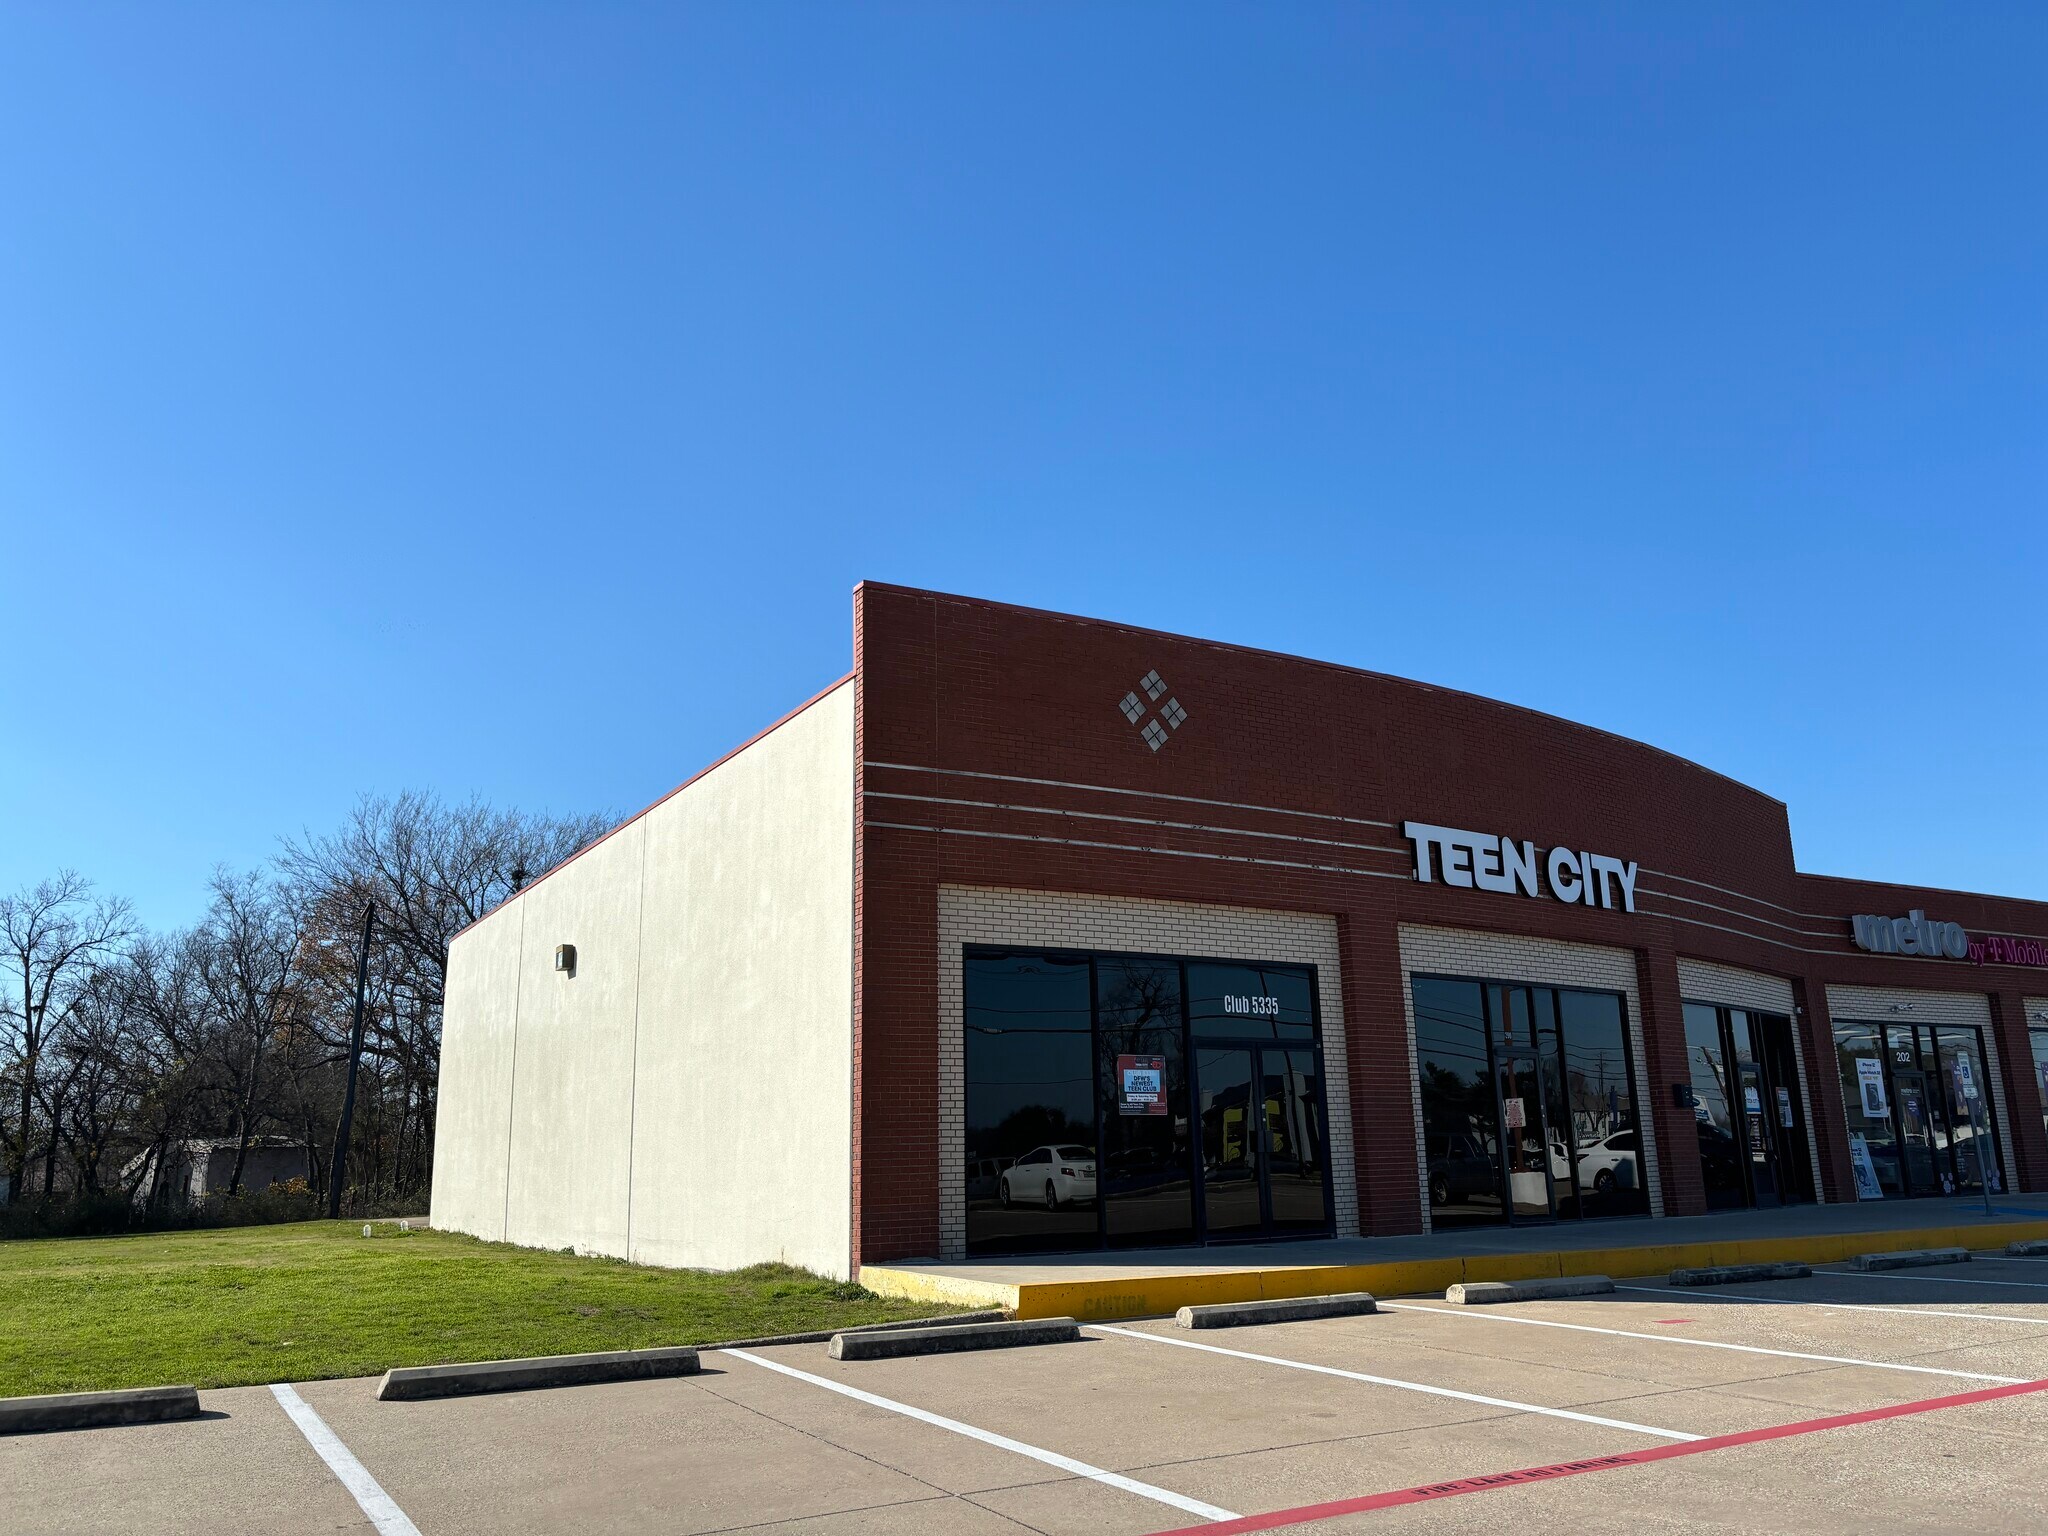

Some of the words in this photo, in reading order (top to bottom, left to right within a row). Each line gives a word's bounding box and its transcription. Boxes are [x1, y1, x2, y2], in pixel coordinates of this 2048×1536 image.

[1402, 820, 1539, 898] TEEN
[1546, 845, 1638, 913] CITY
[1852, 909, 1968, 959] metro
[1966, 936, 1985, 967] by
[1224, 995, 1249, 1013] Club
[1252, 996, 1279, 1014] 5335
[1896, 1052, 1911, 1062] 202
[1083, 1294, 1146, 1314] CAUTION
[1412, 1483, 1466, 1495] FIRE
[1465, 1474, 1524, 1487] LANE
[1522, 1468, 1553, 1478] NO
